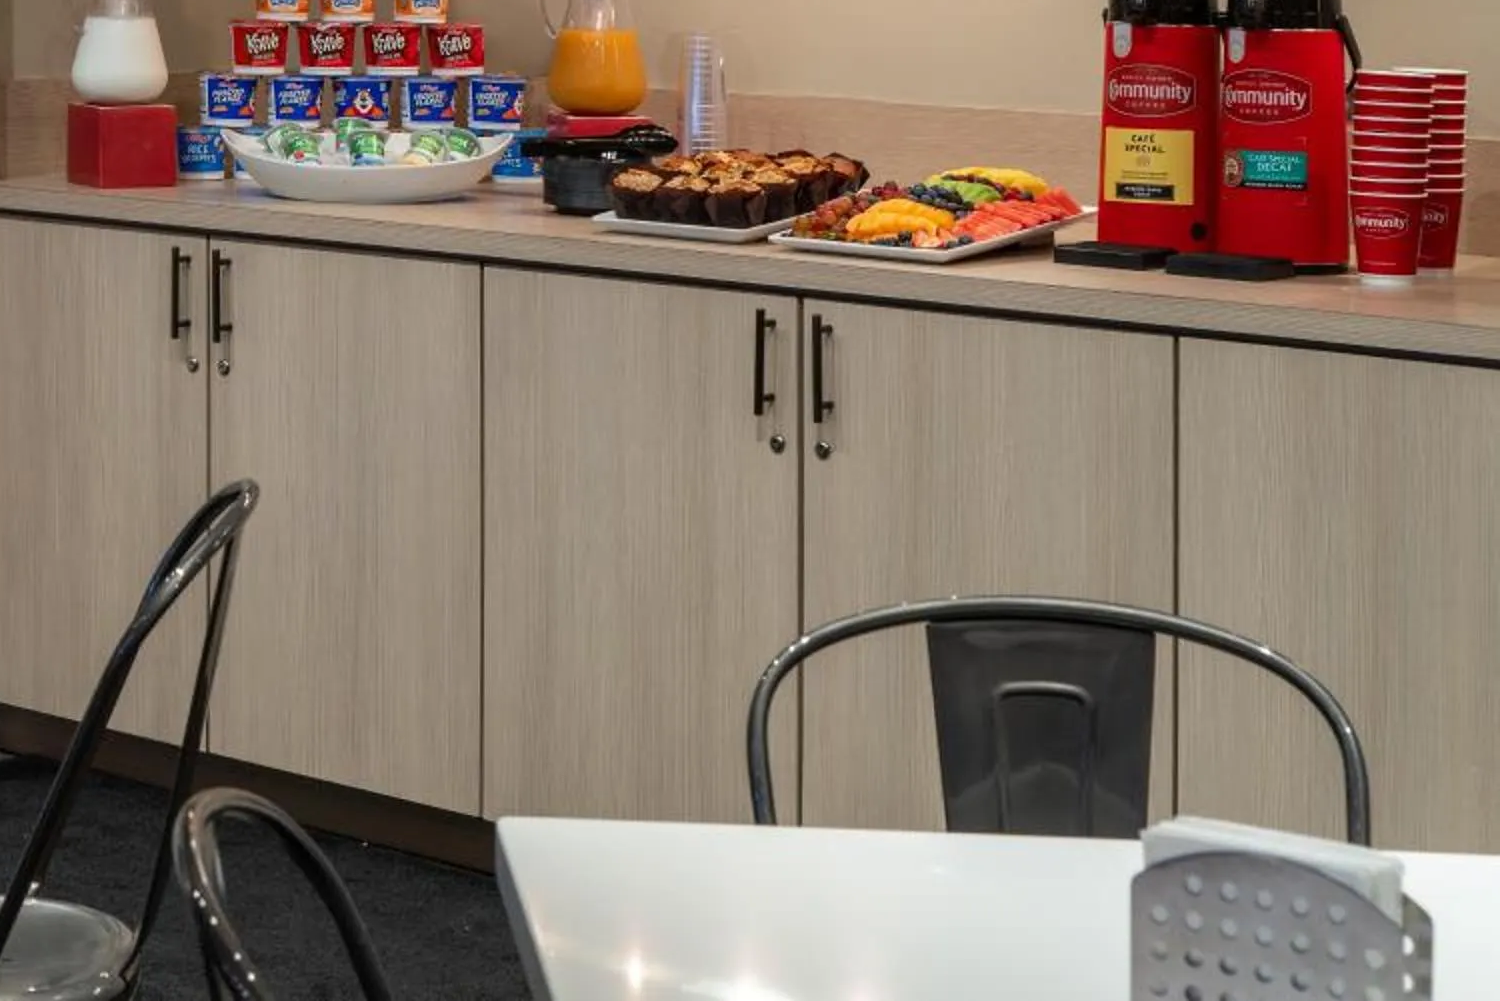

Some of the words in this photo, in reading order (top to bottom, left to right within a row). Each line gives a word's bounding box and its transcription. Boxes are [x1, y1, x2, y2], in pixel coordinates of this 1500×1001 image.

[1108, 78, 1192, 104] Community
[1225, 84, 1307, 111] Community
[1124, 144, 1167, 154] SPECIAL
[1256, 162, 1292, 172] DECAF
